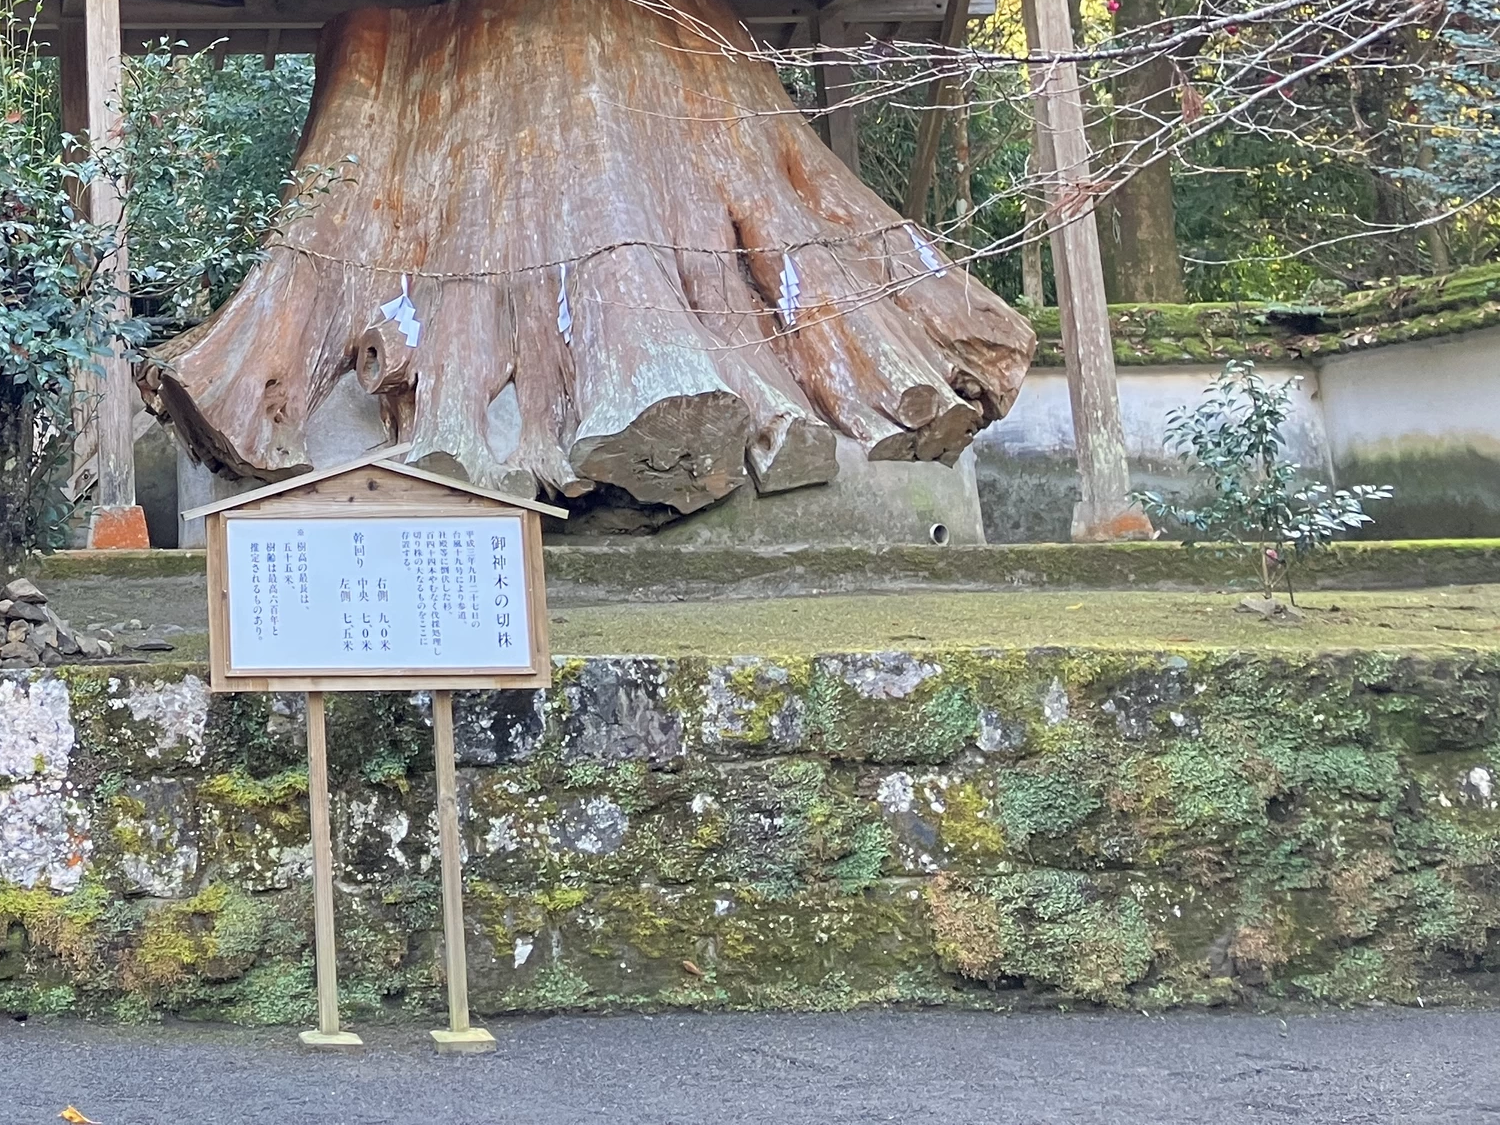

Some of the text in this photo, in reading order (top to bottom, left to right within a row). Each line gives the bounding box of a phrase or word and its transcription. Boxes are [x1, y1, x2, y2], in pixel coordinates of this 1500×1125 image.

[353, 532, 365, 568] 幹回り
[339, 577, 351, 603] 左側
[357, 577, 369, 602] 中央
[377, 577, 389, 602] 右側
[490, 536, 512, 648] 御神木の切株
